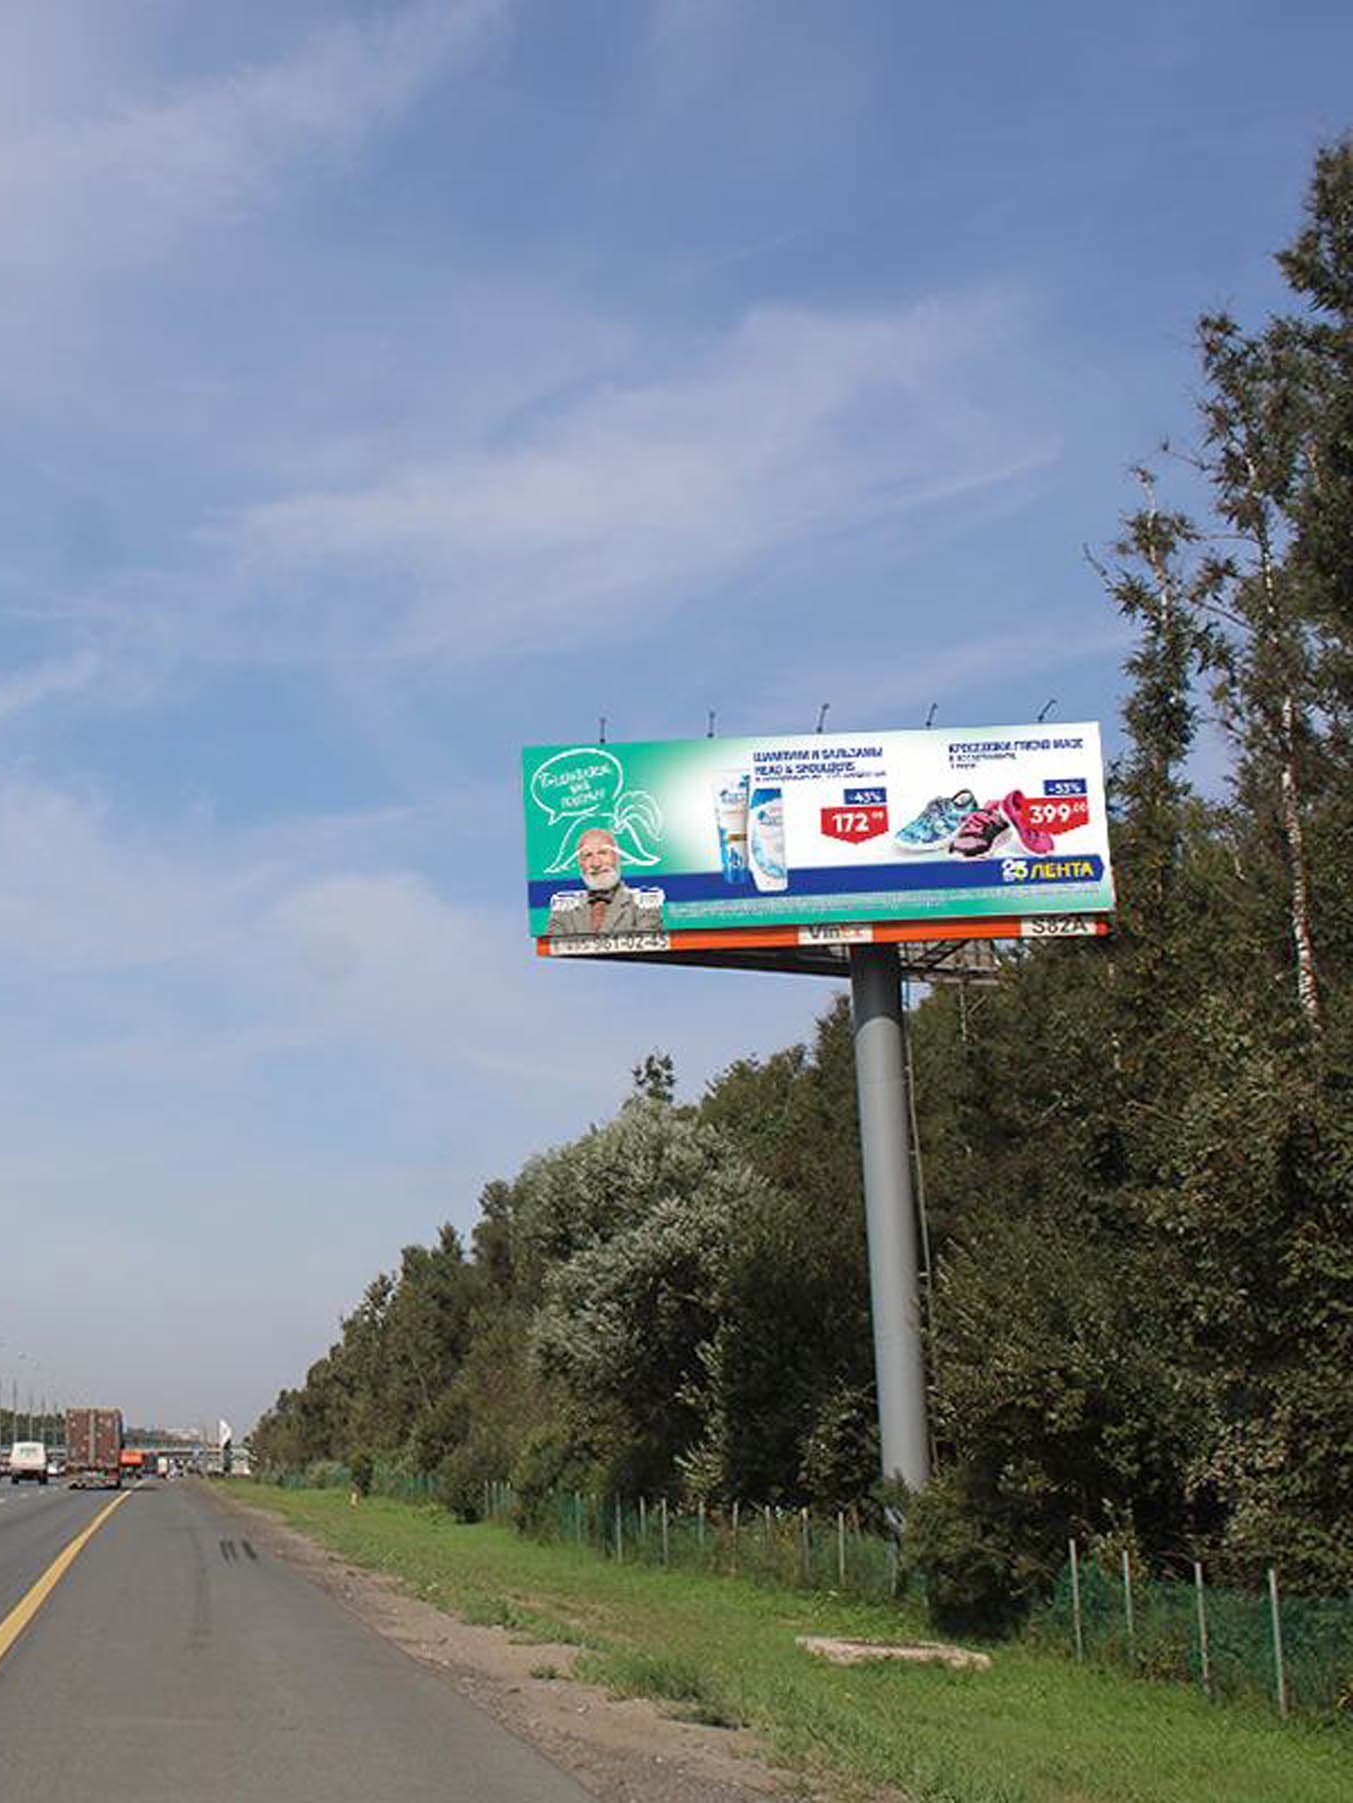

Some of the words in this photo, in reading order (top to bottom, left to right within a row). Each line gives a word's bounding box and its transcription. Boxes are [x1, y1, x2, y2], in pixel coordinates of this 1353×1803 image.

[832, 811, 869, 832] 172
[1030, 803, 1070, 823] 399
[1030, 861, 1094, 879] ЛЕНТА
